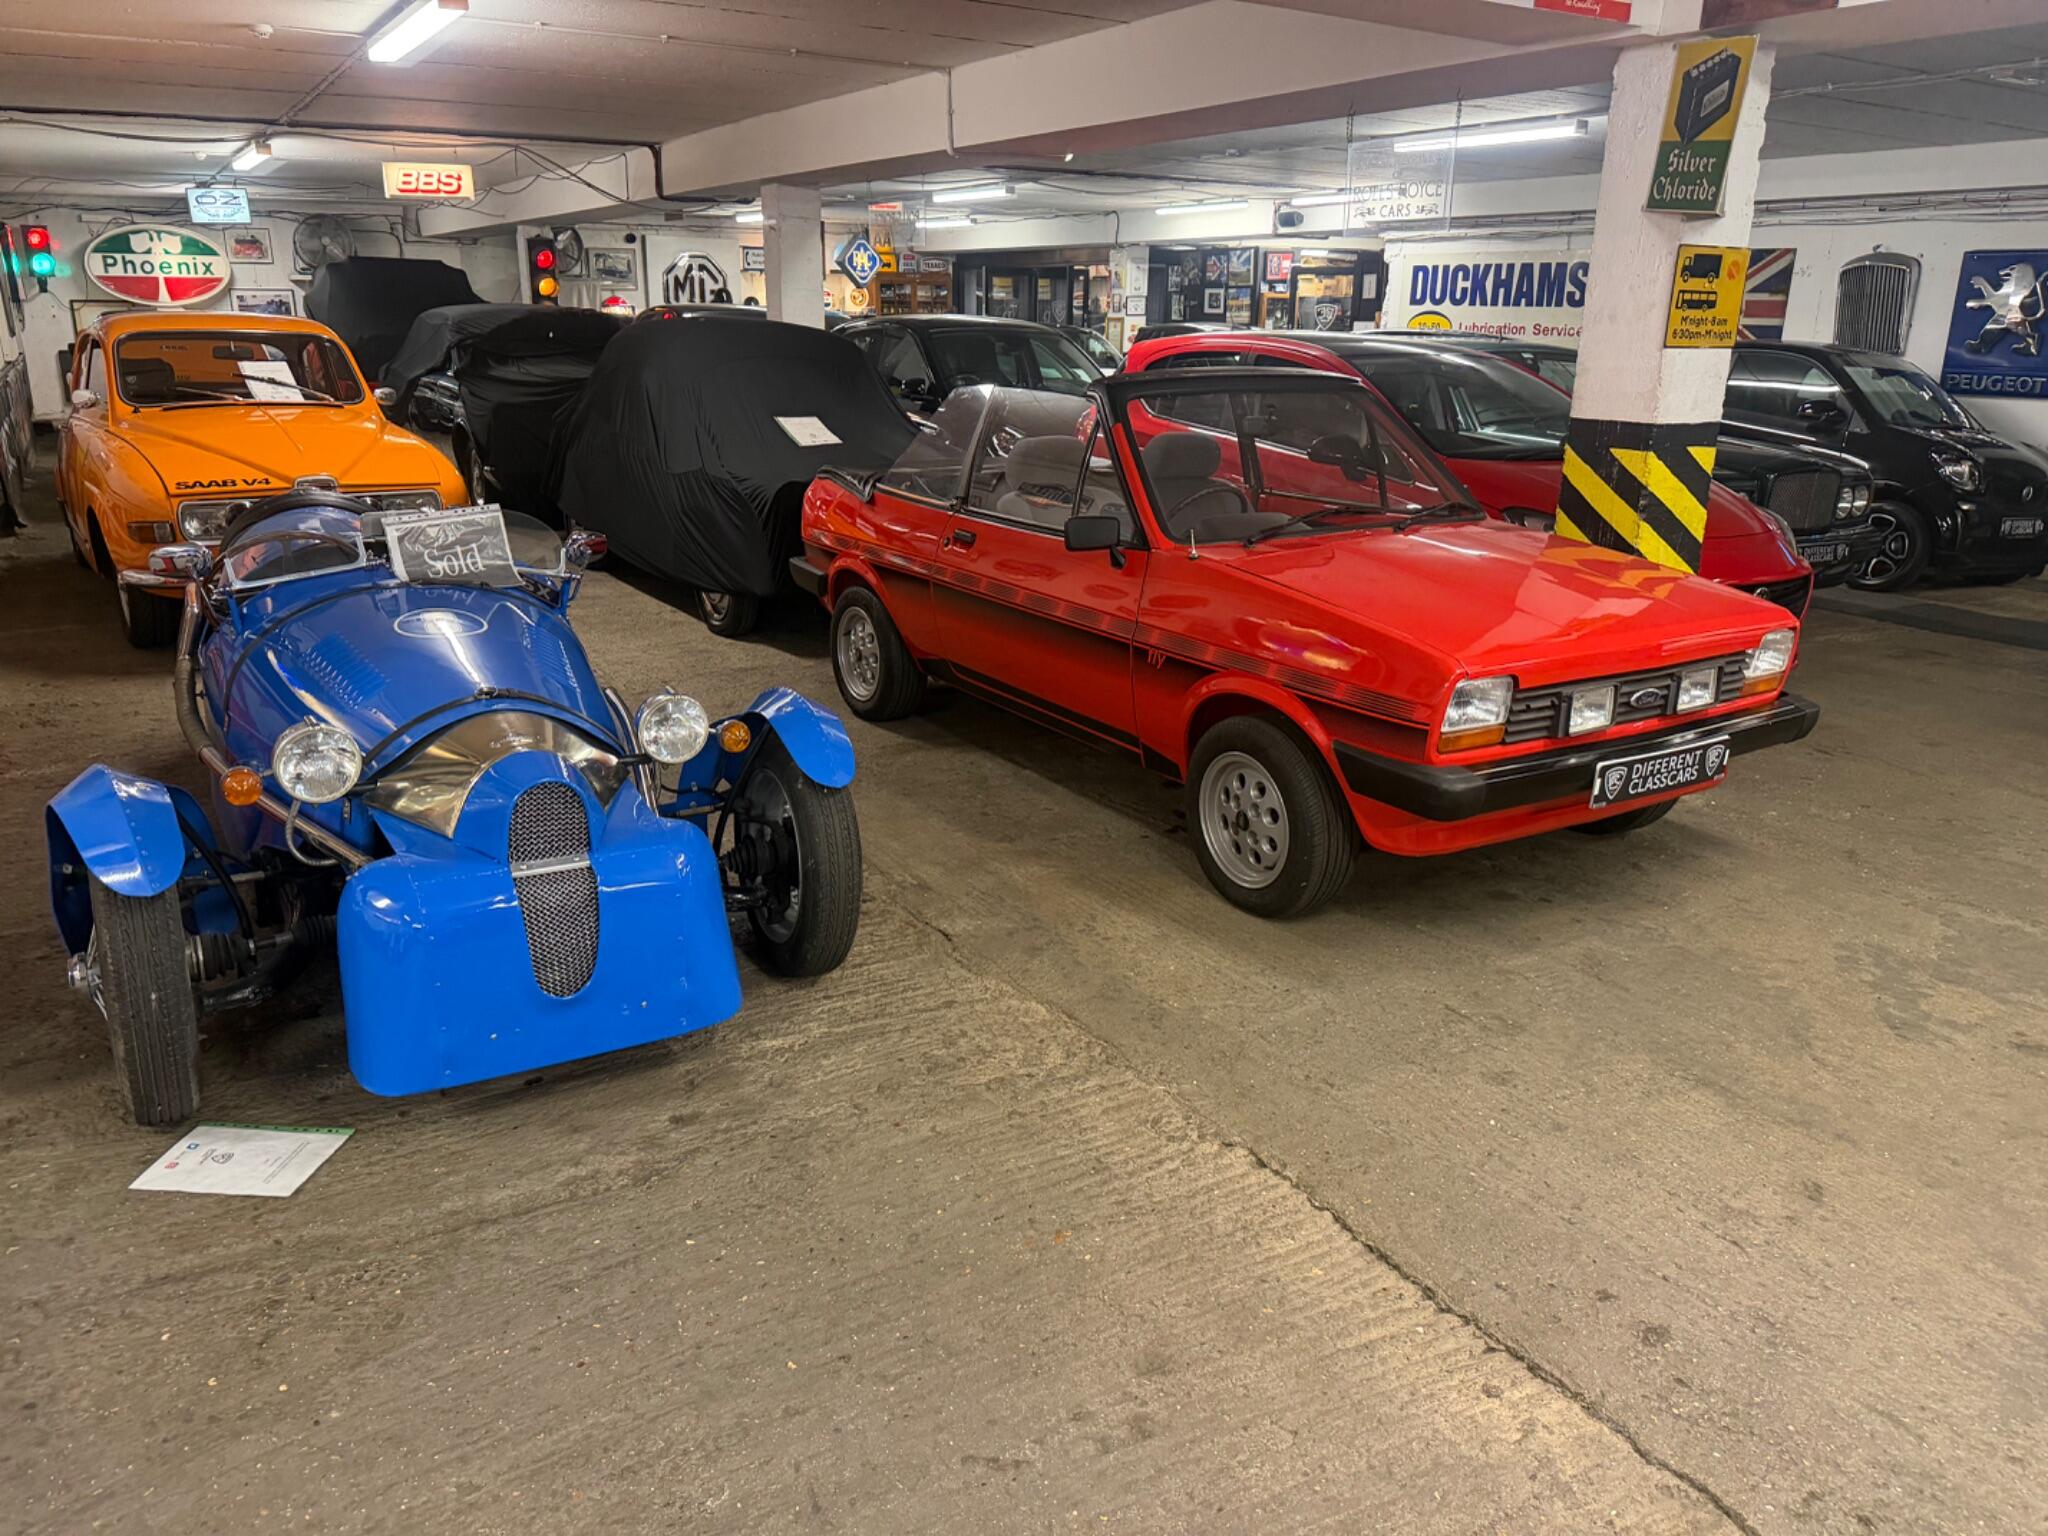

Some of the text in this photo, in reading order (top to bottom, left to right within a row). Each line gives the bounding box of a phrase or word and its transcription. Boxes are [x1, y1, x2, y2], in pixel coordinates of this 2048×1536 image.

[1668, 148, 1716, 173] Silver
[396, 168, 463, 194] BBS
[1653, 175, 1716, 203] Chloride
[1380, 203, 1412, 218] CARS
[101, 254, 216, 276] Phoenix
[673, 262, 720, 303] MG
[1409, 261, 1590, 309] DUCKHAMS
[1532, 323, 1583, 338] Service
[1946, 373, 2047, 393] PEUGEOT
[175, 477, 272, 490] SAAB V4
[423, 543, 487, 579] Sold
[1631, 749, 1704, 780] DIFFERENT
[1627, 765, 1700, 795] CLASSCARS
